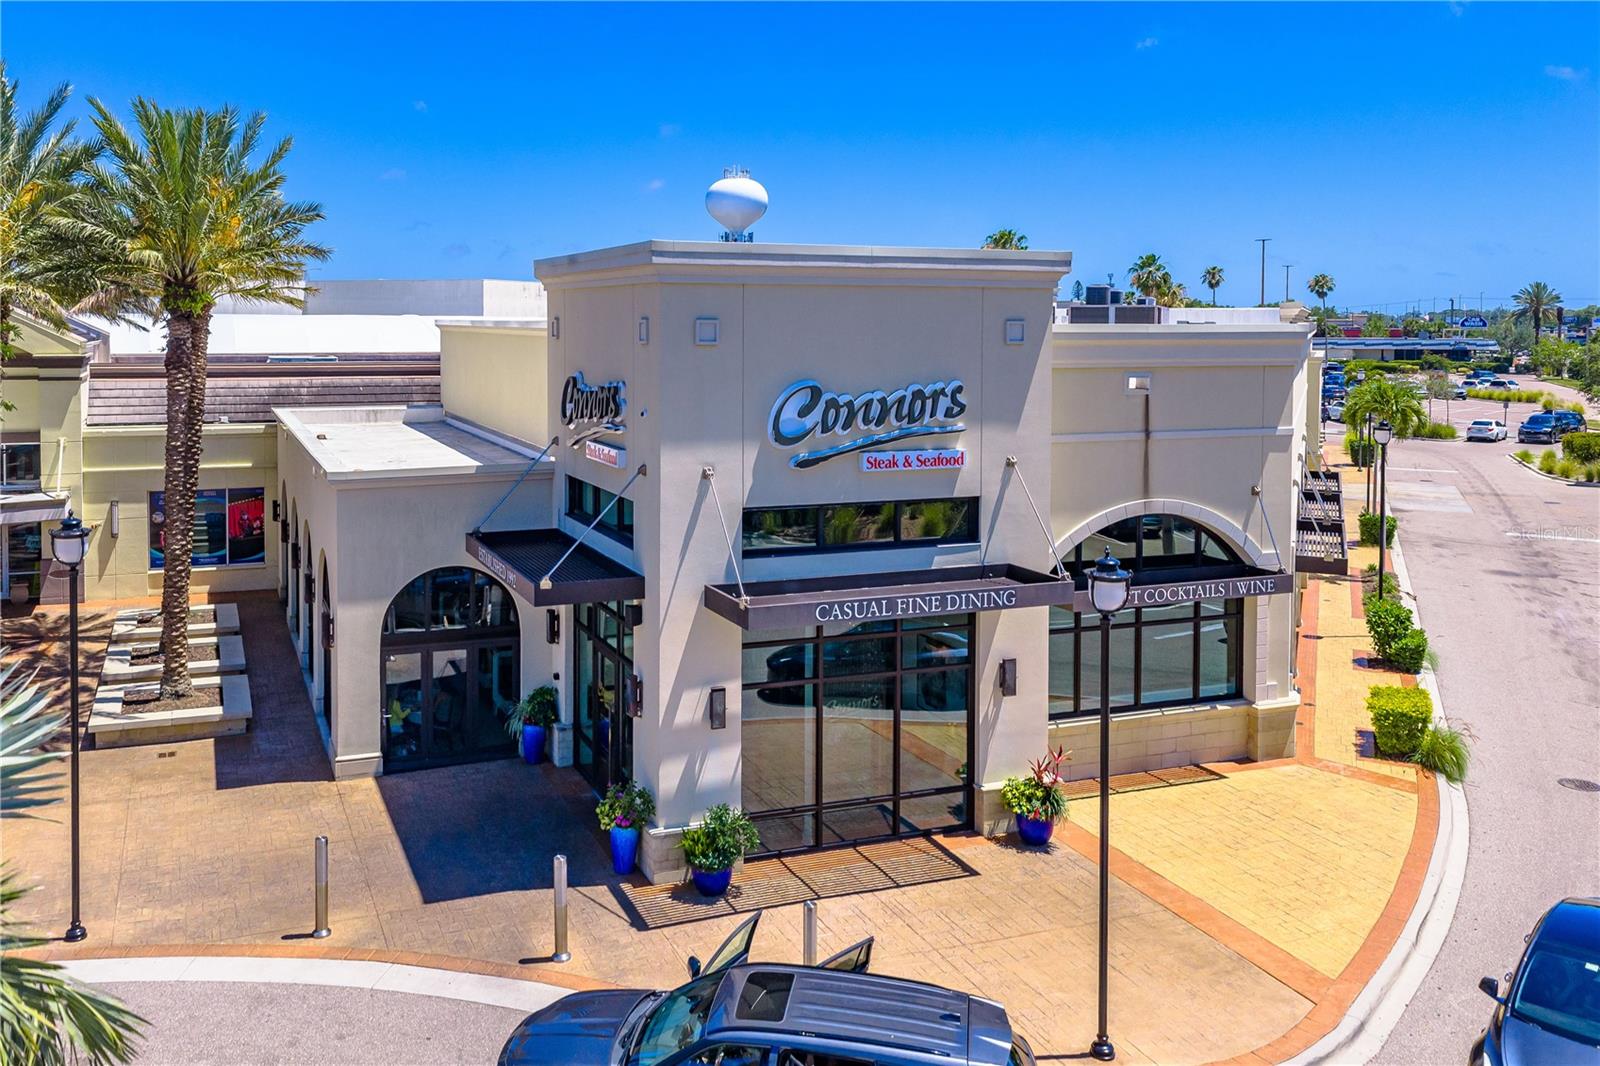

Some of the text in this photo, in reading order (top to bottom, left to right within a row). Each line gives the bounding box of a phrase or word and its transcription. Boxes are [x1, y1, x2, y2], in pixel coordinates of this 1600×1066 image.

[561, 373, 625, 426] Connors
[769, 380, 967, 447] Connors
[866, 452, 964, 470] Steak & Seafood
[815, 590, 1016, 621] CASUAL FINE DINING
[1144, 583, 1225, 604] COCKTAILS
[1237, 579, 1276, 595] WINE
